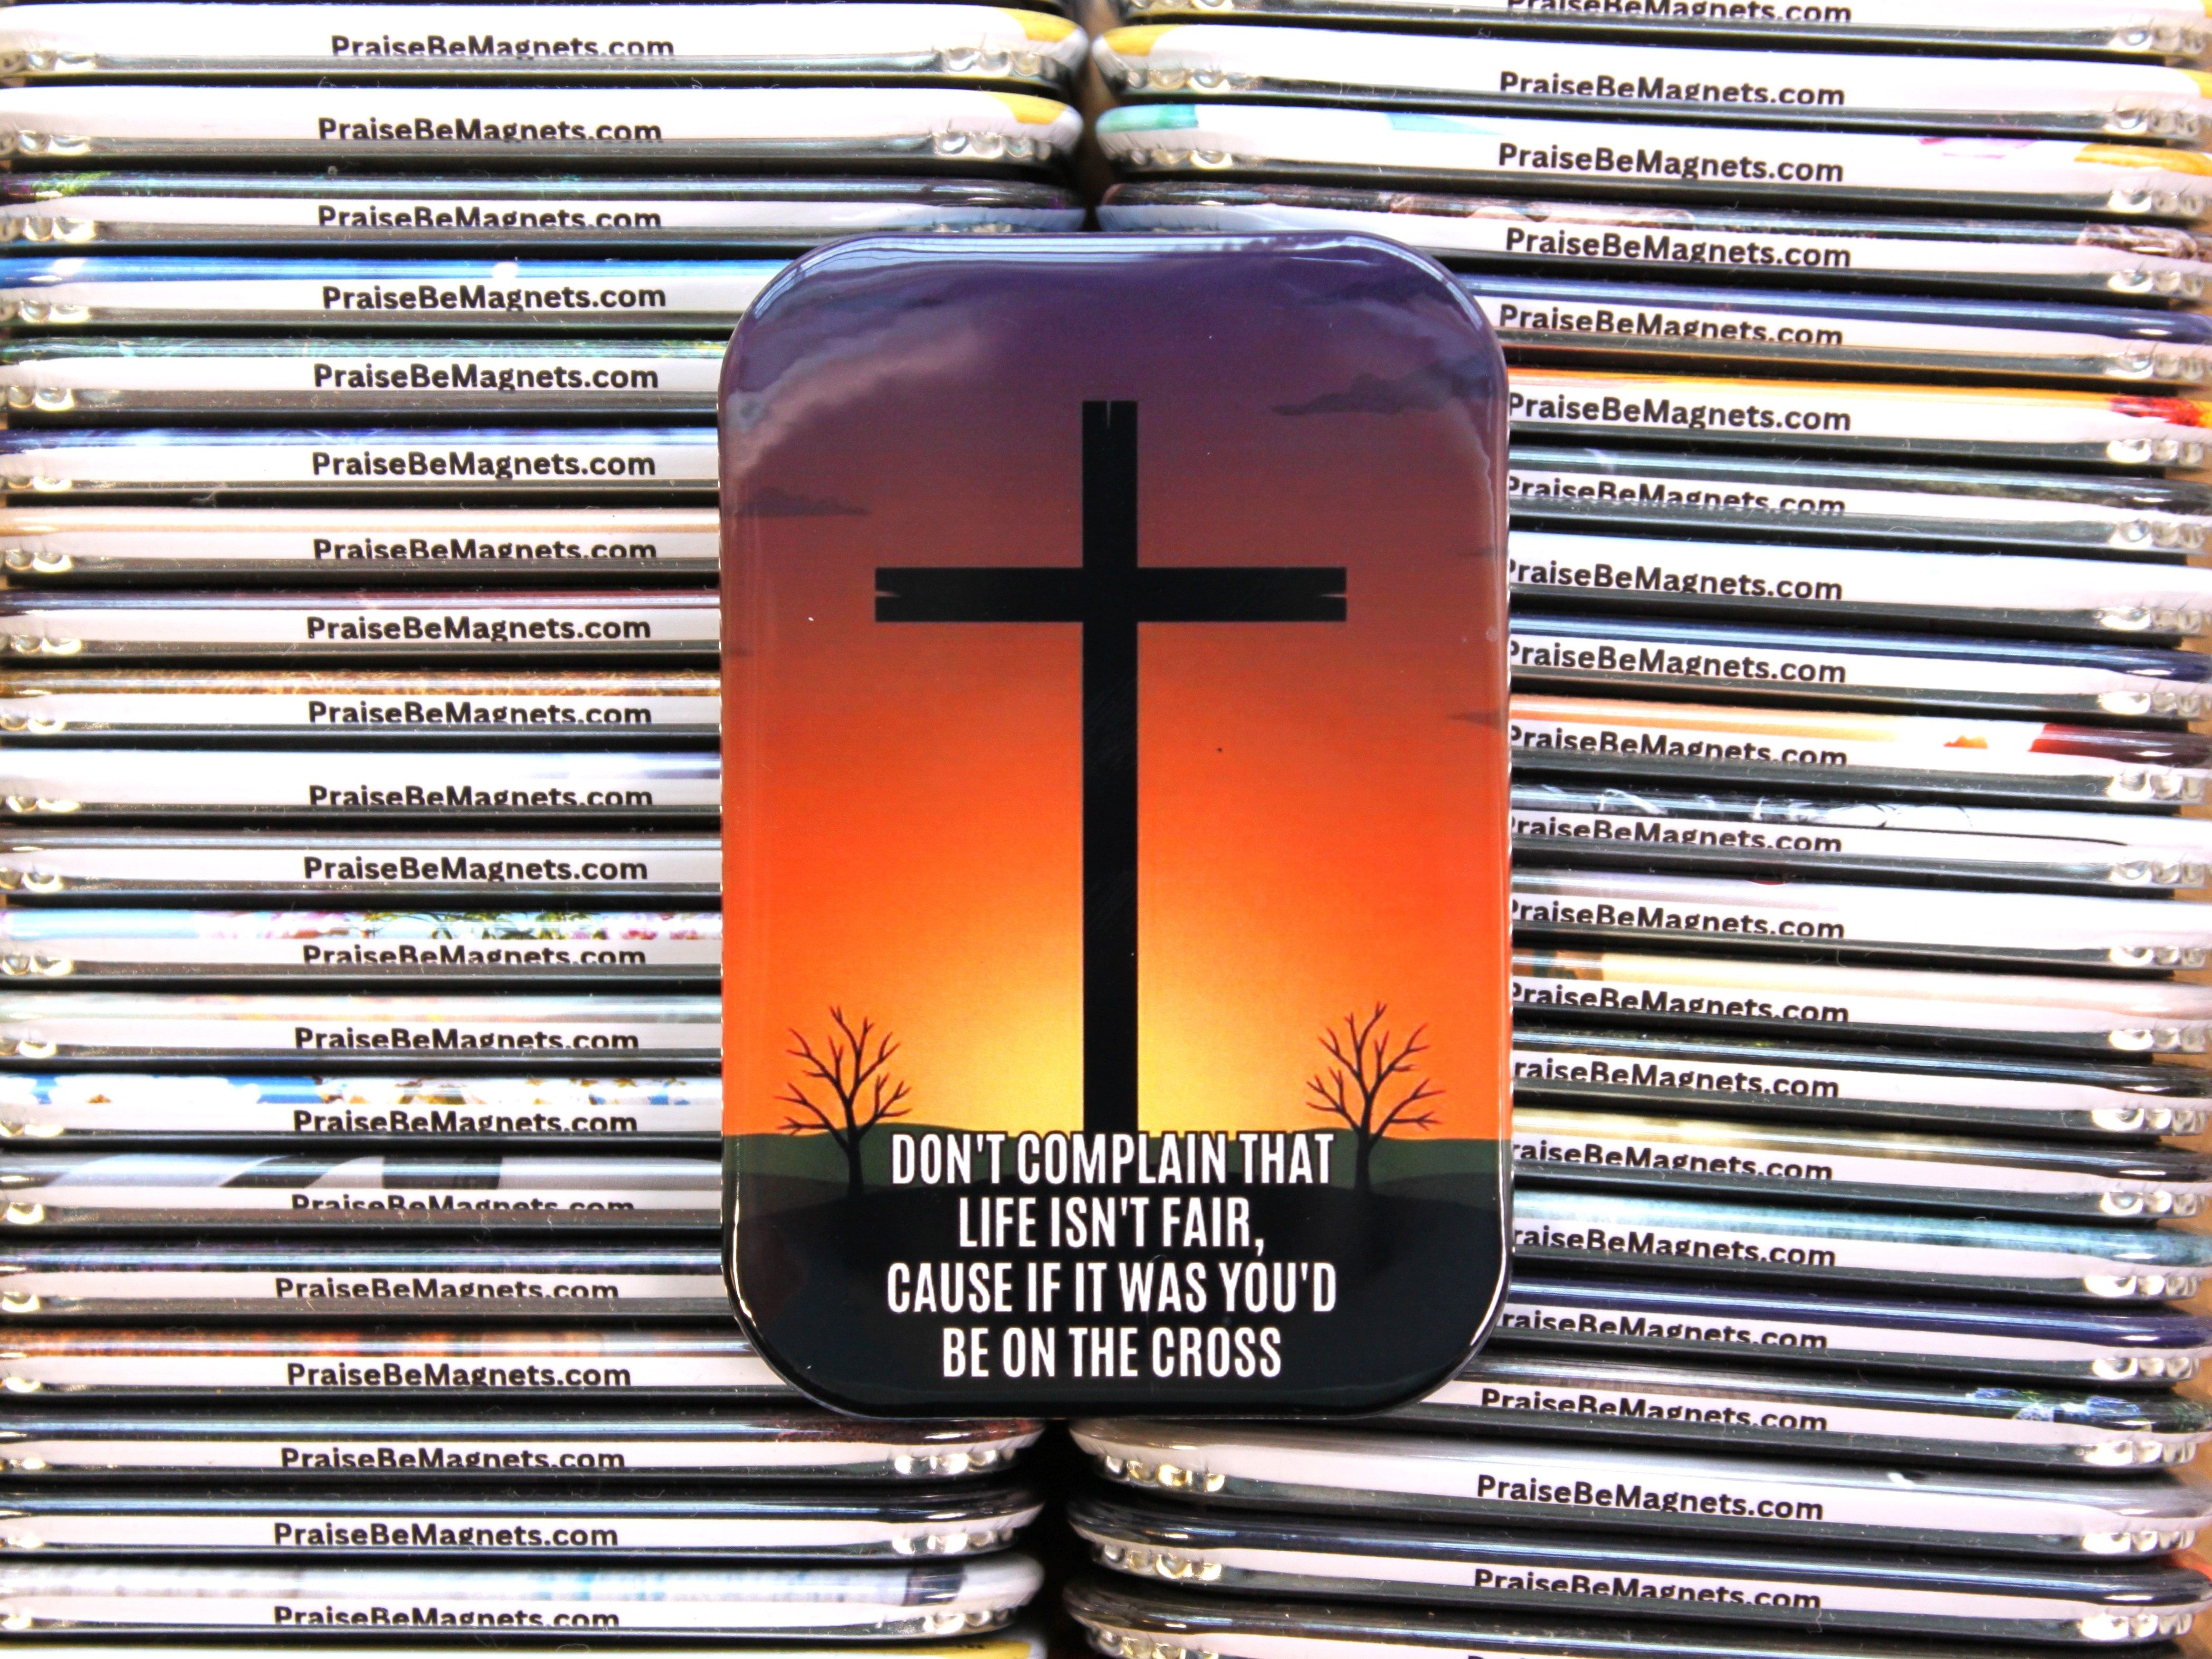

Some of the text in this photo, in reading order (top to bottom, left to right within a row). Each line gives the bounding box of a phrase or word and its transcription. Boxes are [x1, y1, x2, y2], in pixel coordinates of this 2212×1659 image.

[331, 35, 674, 58] PraiseBeMagnets.com
[1499, 71, 1845, 106] PraiseBeMagnets.com
[318, 118, 662, 141] PraiseBeMagnets.com
[1499, 143, 1844, 183] PraiseBeMagnets.com
[317, 206, 662, 229] PraiseBeMagnets.com
[1506, 228, 1852, 267] PraiseBeMagnets.com
[322, 285, 666, 311] PraiseBeMagnets.com
[1500, 304, 1844, 345] PraiseBeMagnets.com
[314, 364, 659, 390] PraiseBeMagnets.com
[1509, 393, 1852, 432] PraiseBeMagnets.com
[312, 453, 655, 480] PraiseBeMagnets.com
[1509, 476, 1846, 514] PraiseBeMagnetscom
[313, 539, 656, 559] PraiseBeMagnets.com
[307, 617, 651, 641] PraiseBeMagnets.com
[308, 701, 652, 724] PraiseBeMagnets.com
[1511, 726, 1847, 766] PraiseBeMagnetscom
[1513, 818, 1843, 852] raiseBeMagnets.com
[303, 856, 648, 882] PraiseBeMagnets.com
[1515, 1059, 1839, 1099] raiseBeMagnets.com
[892, 1134, 1334, 1185] DON'T COMPLAIN THAT
[1514, 1140, 1834, 1179] aiseBeMagnets.com
[291, 1194, 634, 1210] PraiseBeManetscom
[959, 1197, 1265, 1257] LIFE ISN'T FAIR,
[1514, 1225, 1836, 1267] raiseBeMagnets.com
[888, 1262, 1337, 1313] CAUSE IF IT WAS YOU'D
[1503, 1310, 1827, 1349] raiseBeMagnets.com
[943, 1327, 1281, 1378] BE ON THE CROSS
[287, 1364, 631, 1386] PraiseBeMagnets.com
[1476, 1475, 1824, 1520] PraiseBeMagnets.com
[273, 1523, 618, 1546] PraiseBeMagnets.com
